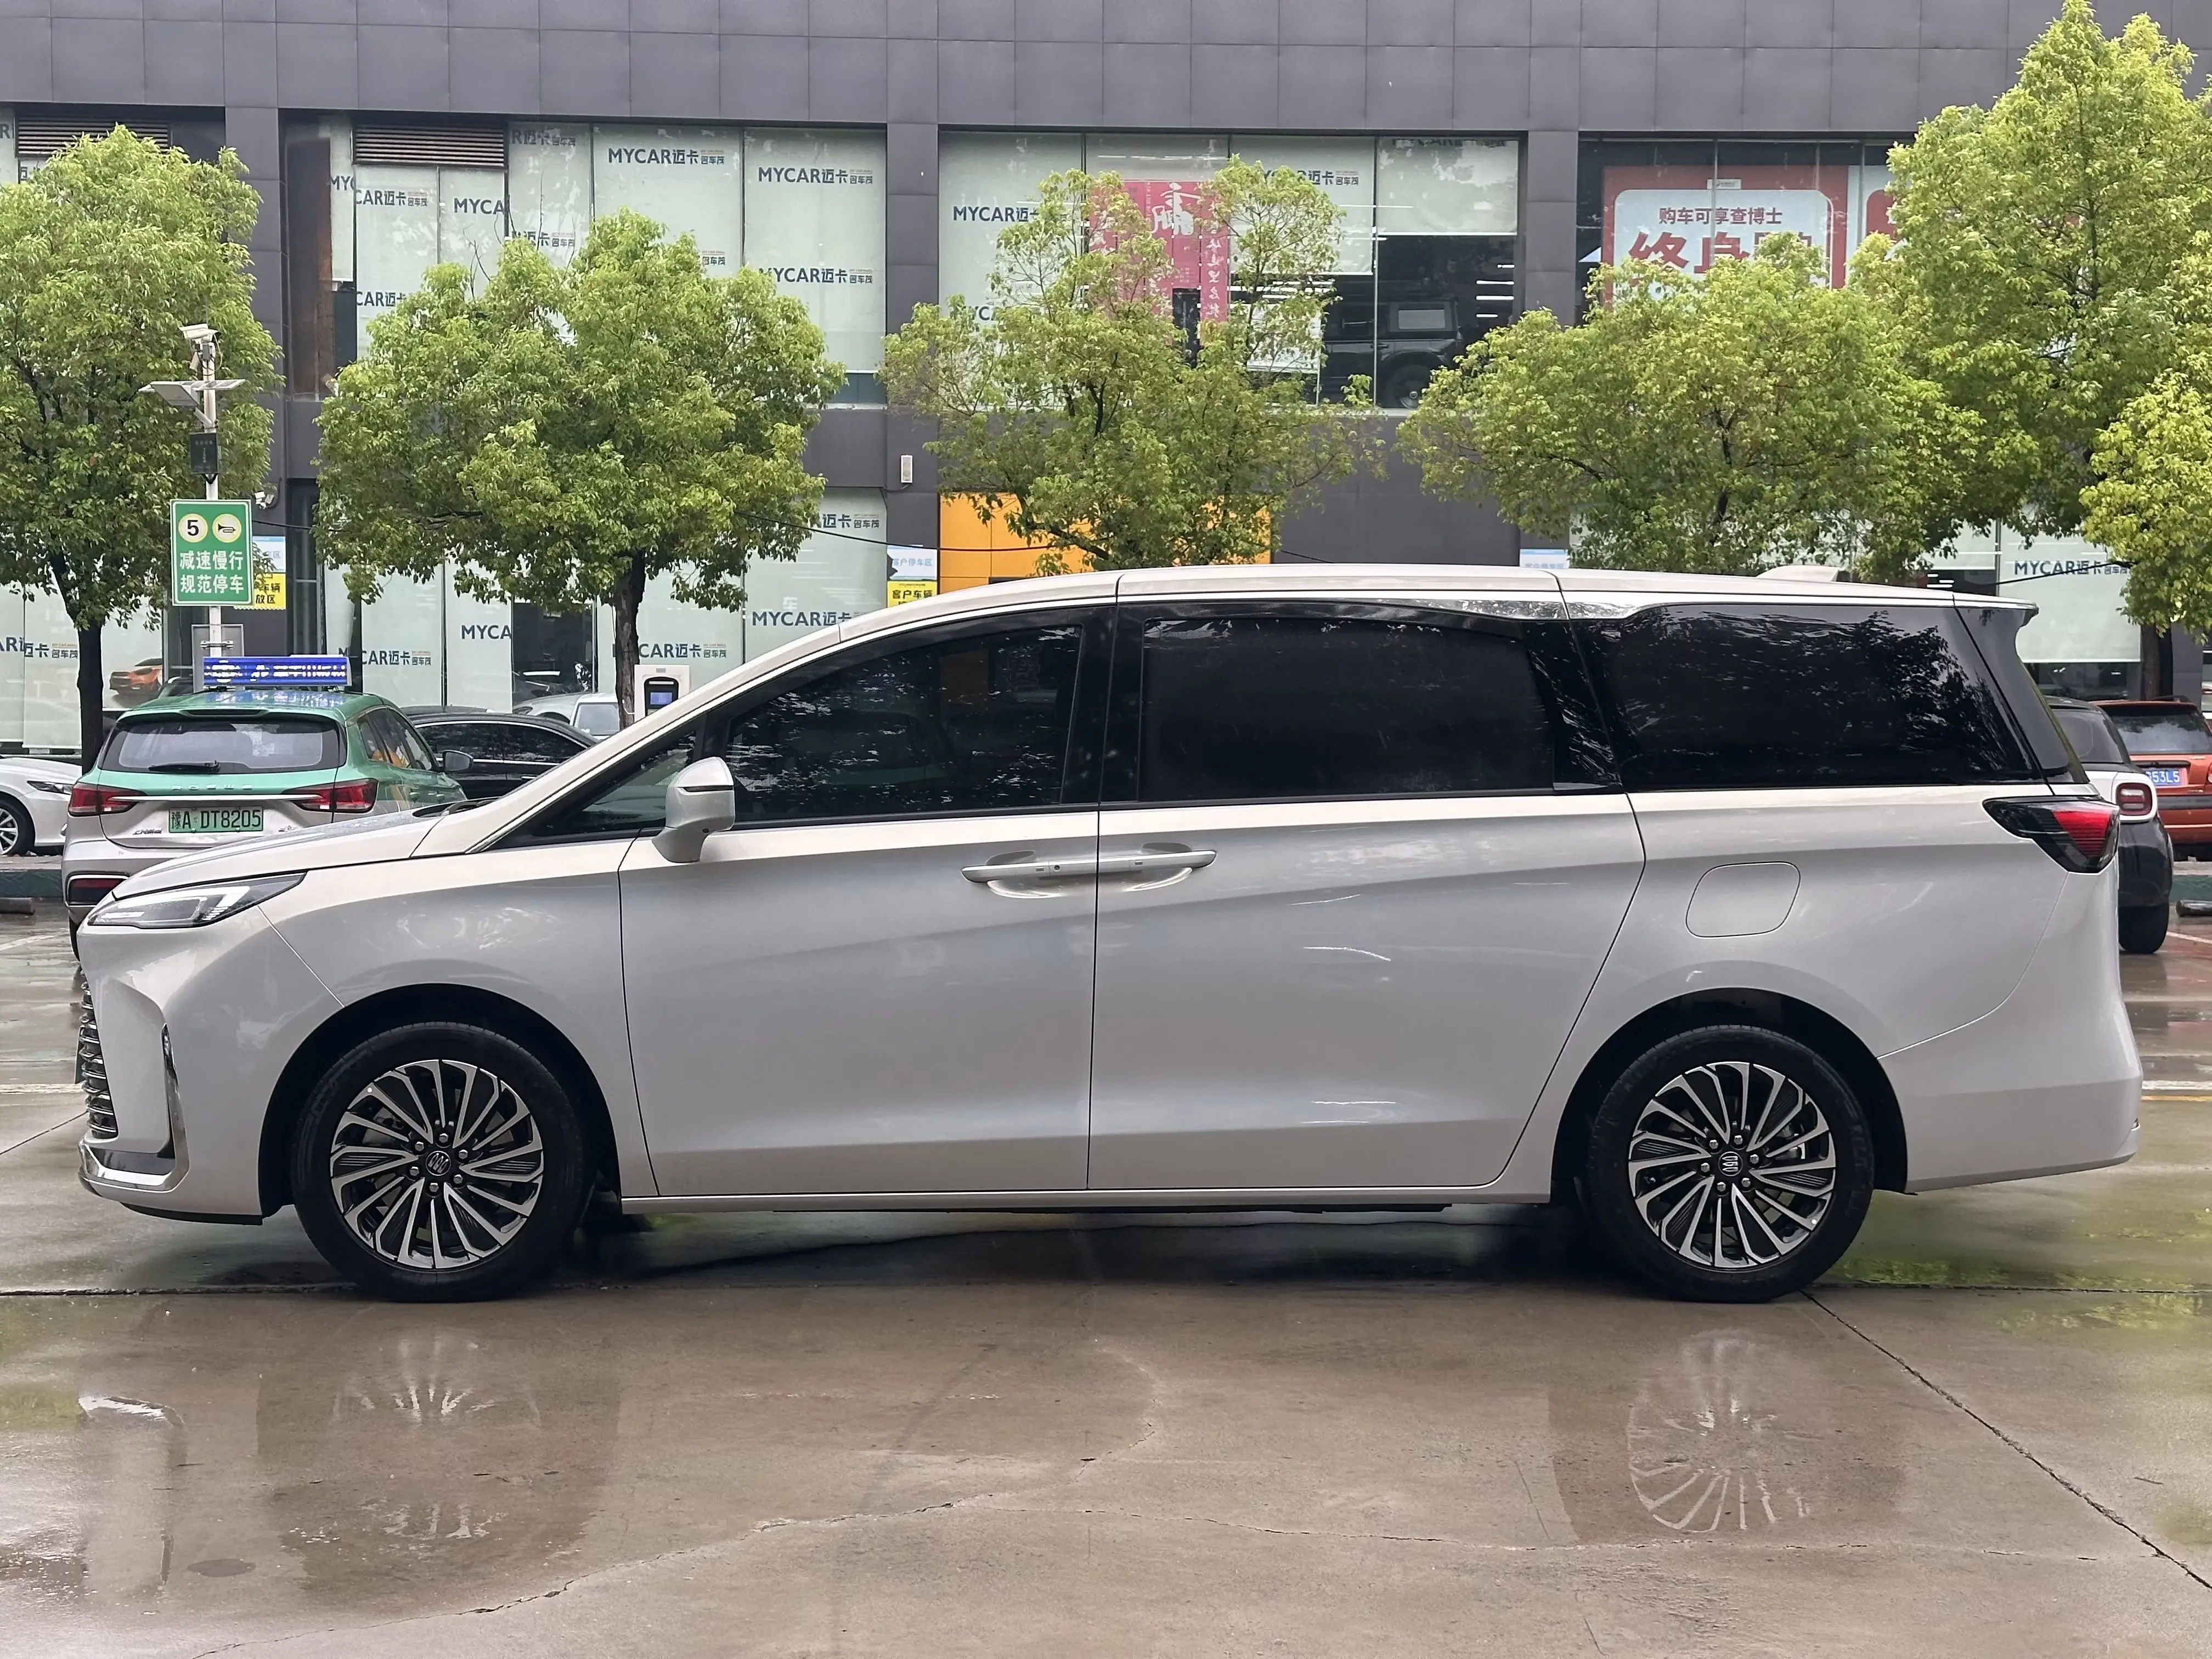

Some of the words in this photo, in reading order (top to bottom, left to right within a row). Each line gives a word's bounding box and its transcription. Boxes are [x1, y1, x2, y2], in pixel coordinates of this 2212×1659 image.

[1658, 207, 1782, 225] 购车可享查博士
[187, 520, 199, 536] 5
[179, 550, 244, 571] 减速慢行
[180, 574, 244, 594] 规范停车
